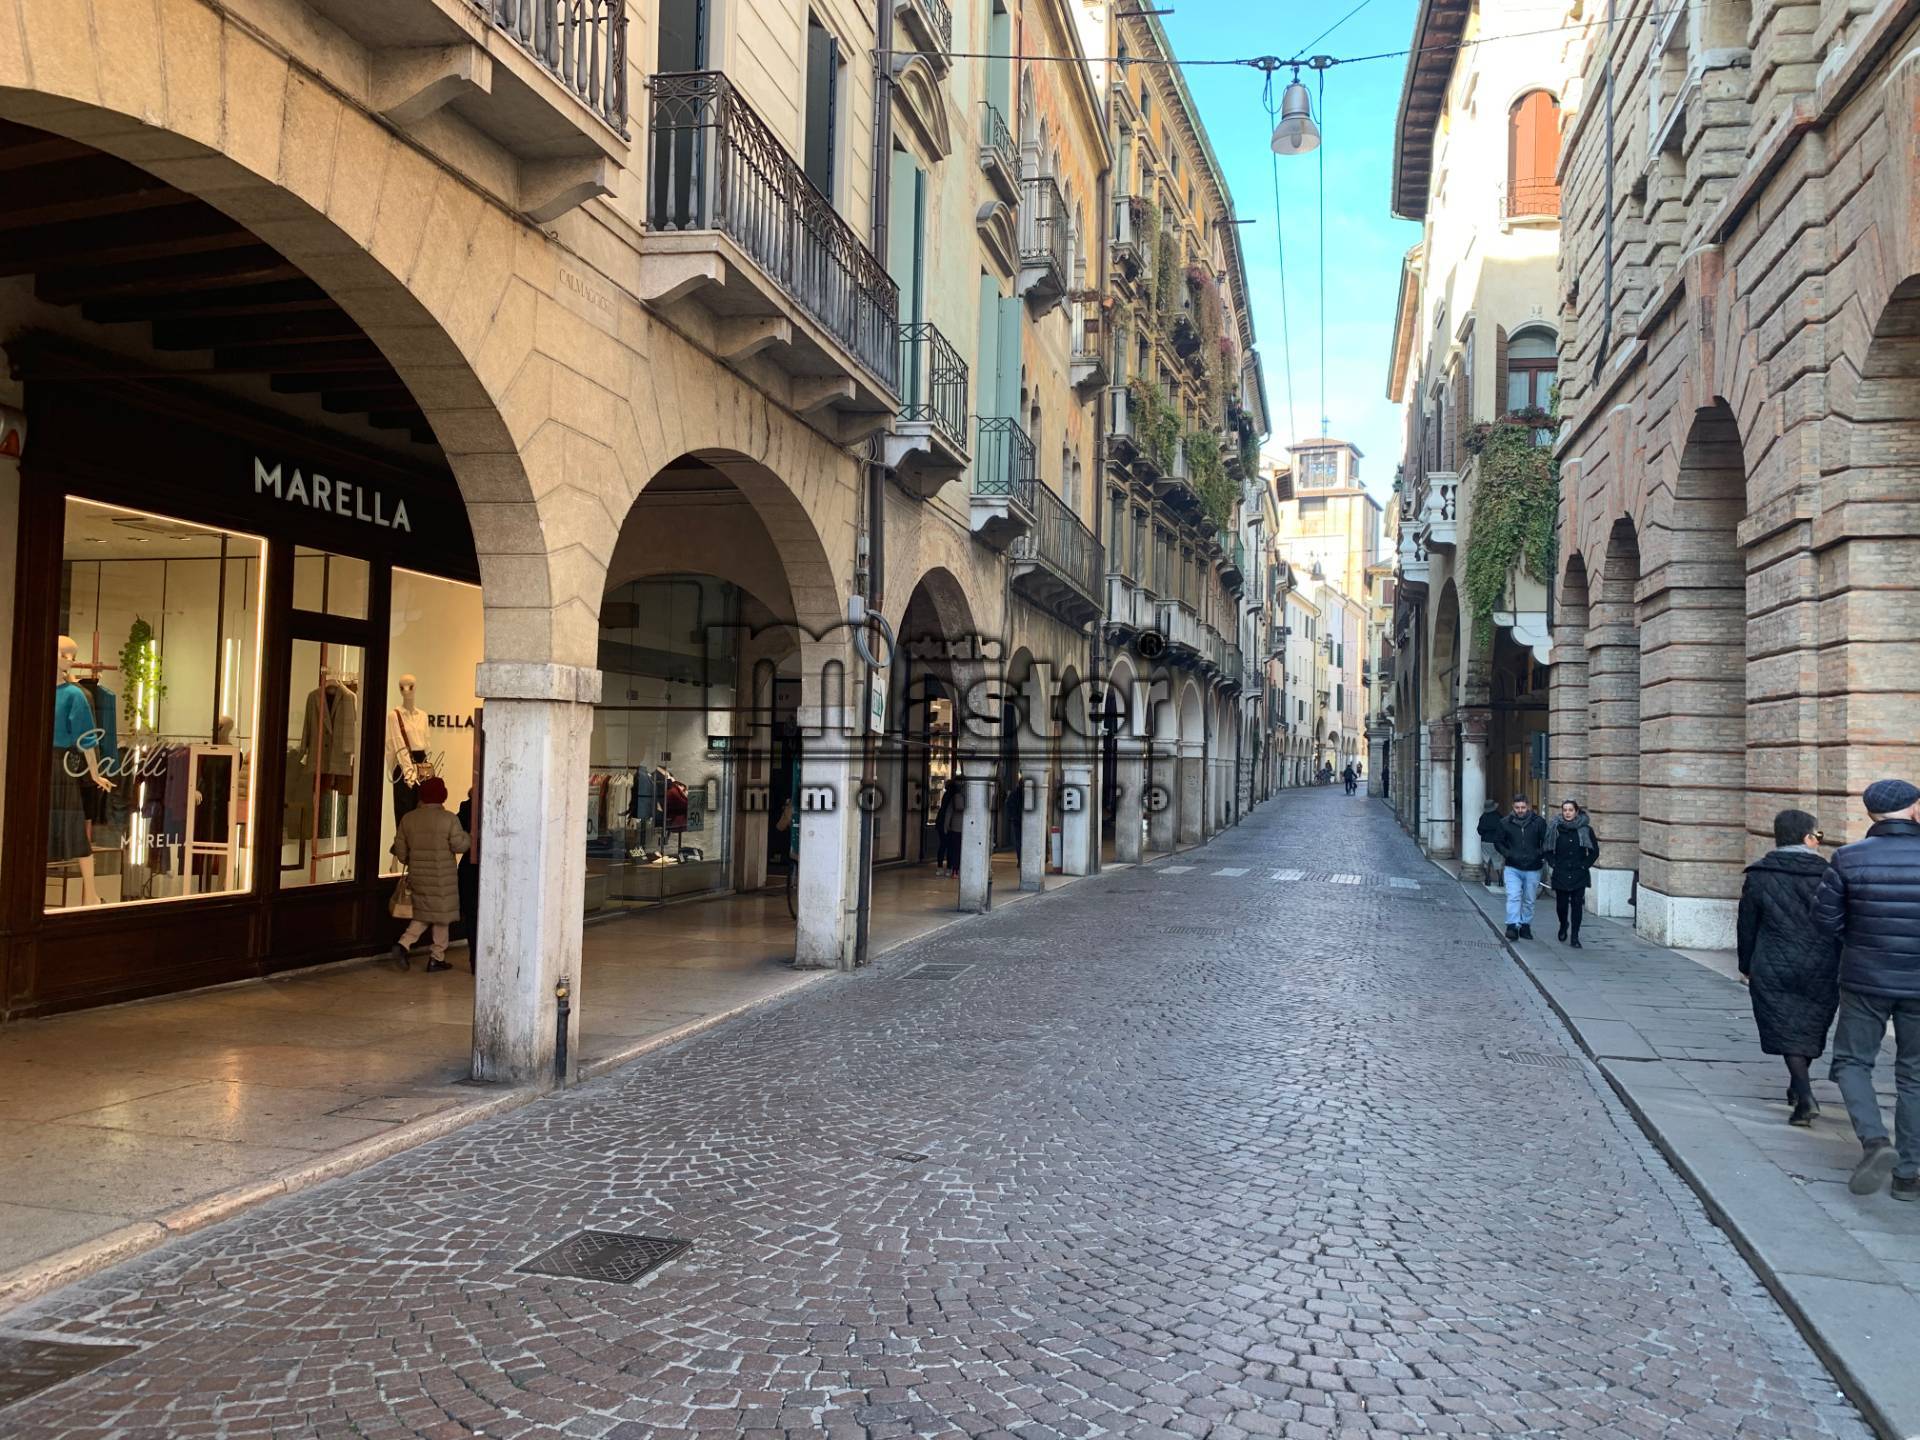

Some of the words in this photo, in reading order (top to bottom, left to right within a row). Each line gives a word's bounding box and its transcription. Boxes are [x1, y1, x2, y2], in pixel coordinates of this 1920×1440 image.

[254, 455, 411, 533] MARELLA
[63, 728, 168, 778] Saldi
[120, 832, 187, 849] MRELL
